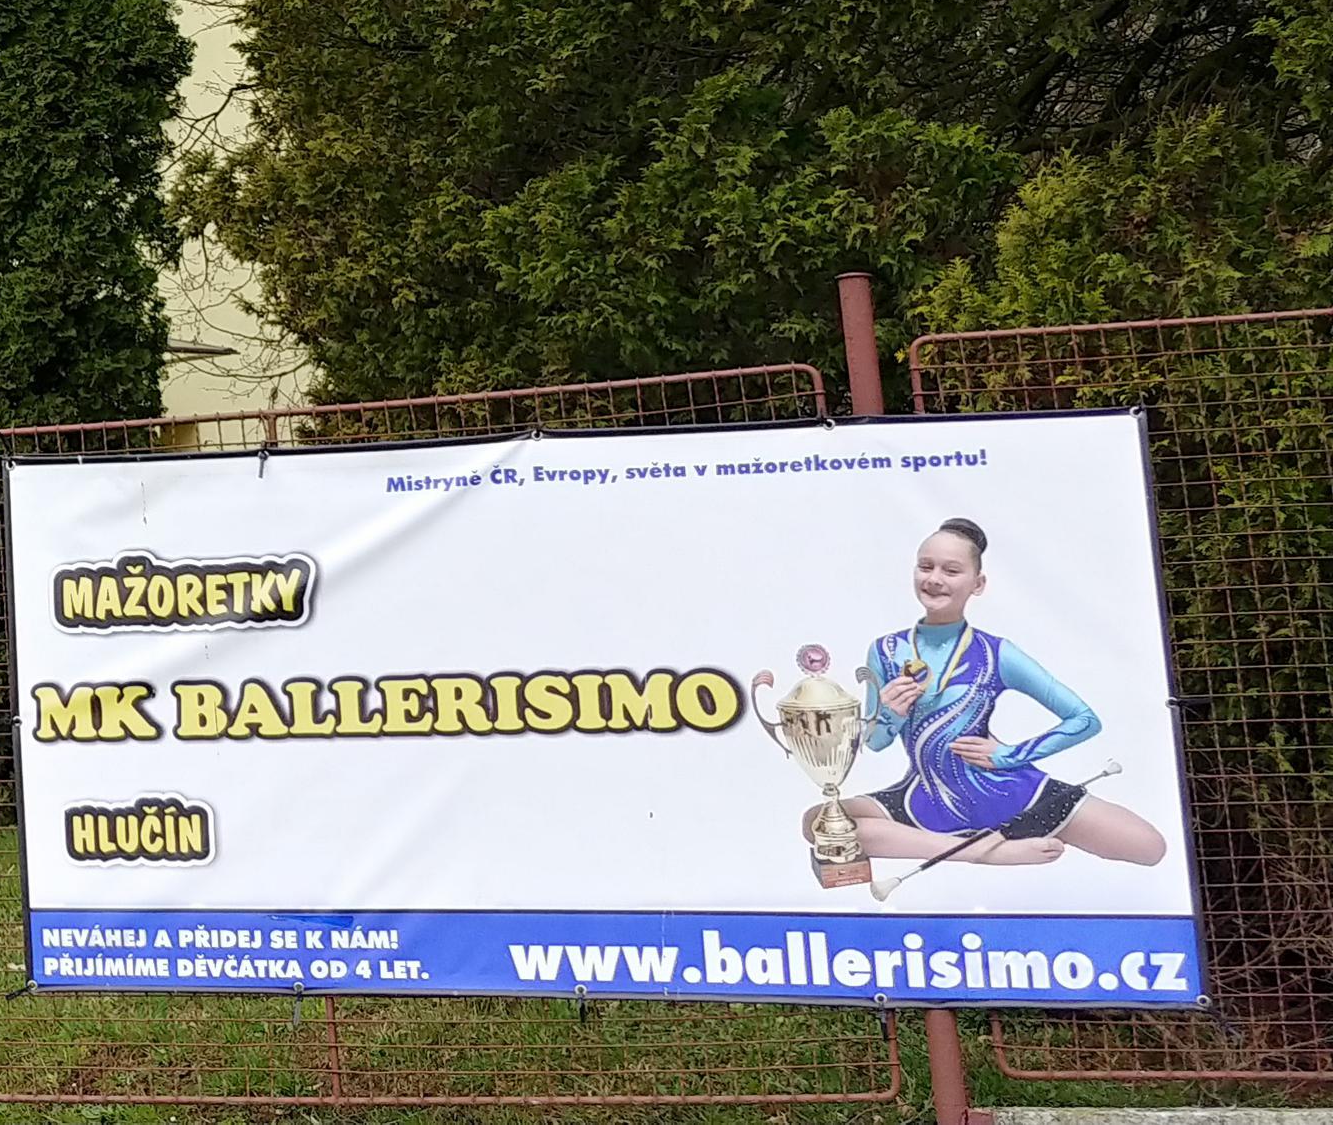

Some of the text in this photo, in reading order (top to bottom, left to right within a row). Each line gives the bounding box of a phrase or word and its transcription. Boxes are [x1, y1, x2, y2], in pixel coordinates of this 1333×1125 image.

[386, 449, 987, 492] Mistryně ČR, Evropy, světa v mažoretkovém sportu!
[62, 564, 302, 620] MAŽORETKY
[34, 670, 743, 742] MK BALLERISIMO
[71, 805, 203, 854] HLUČÍN
[42, 925, 399, 950] NEVÁHEJ A PŘIDEJ SE K NÁM!
[509, 931, 1188, 991] www.ballerisimo.cz
[43, 953, 430, 980] PŘIJÍMÍME DĚVČÁTKA OD 4 LET.
